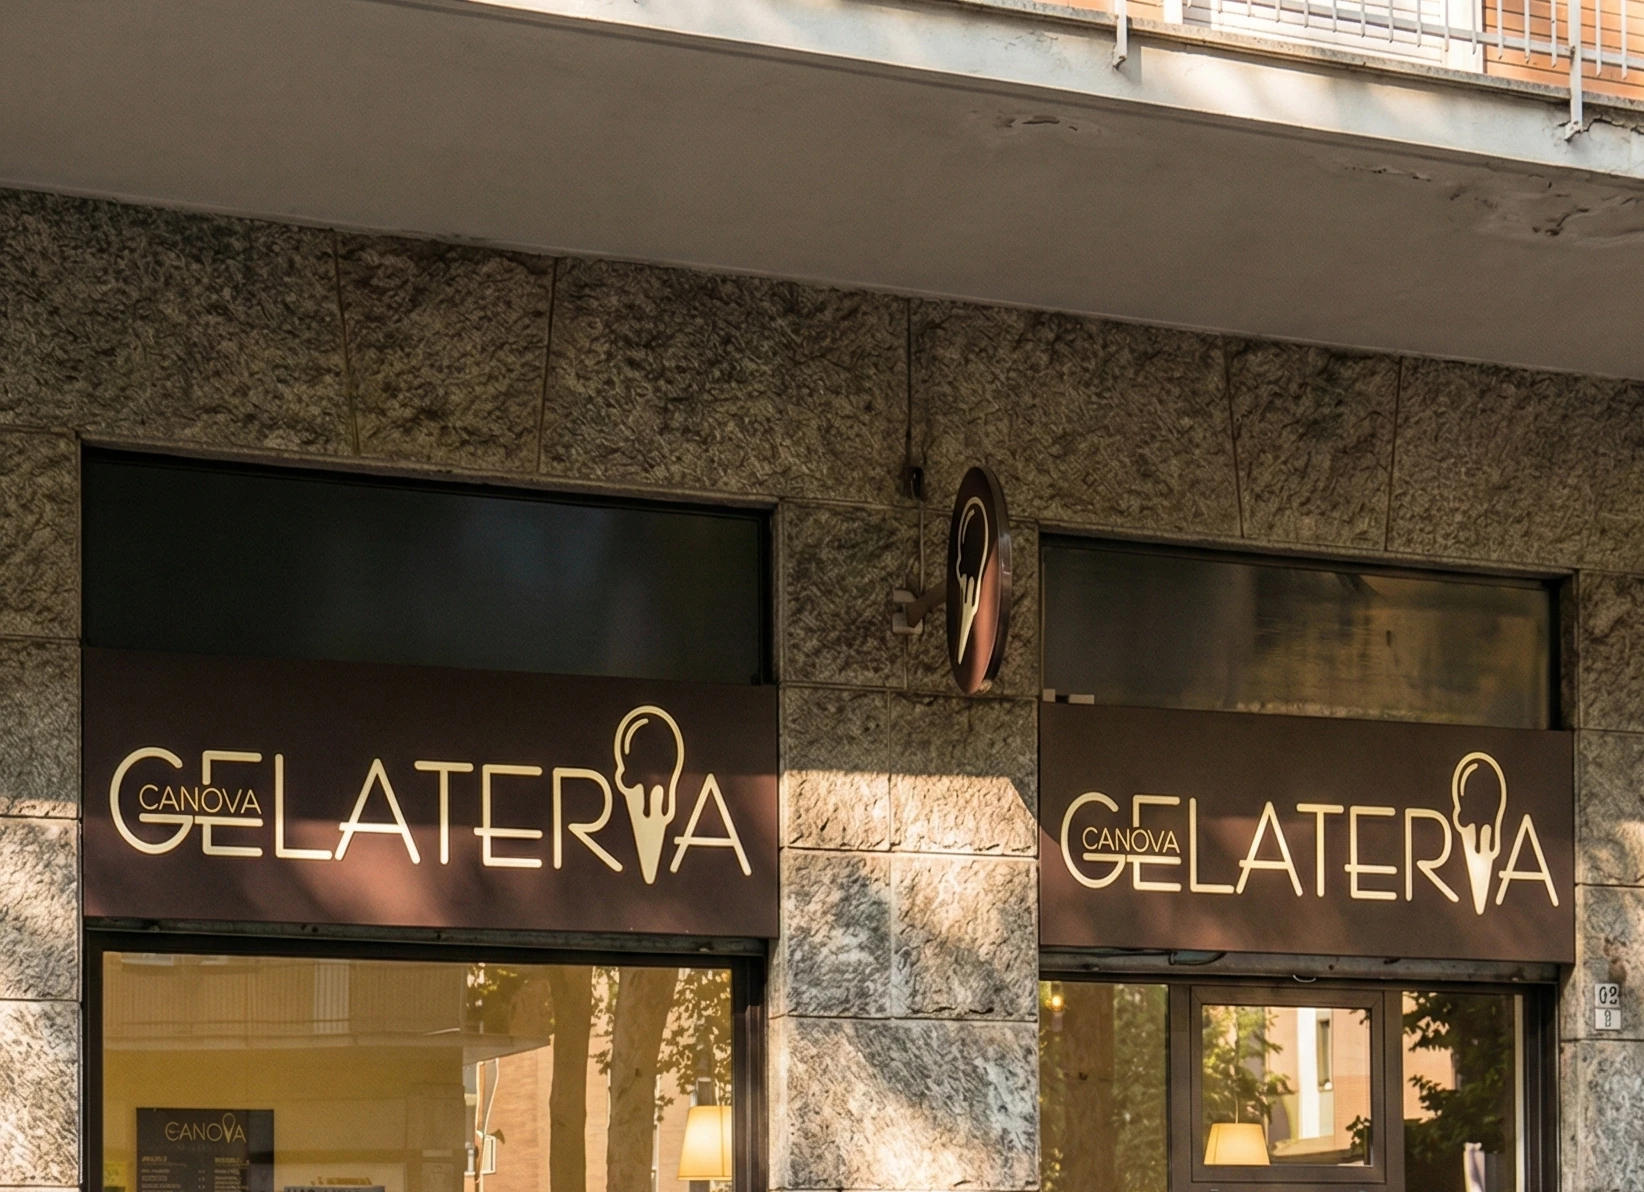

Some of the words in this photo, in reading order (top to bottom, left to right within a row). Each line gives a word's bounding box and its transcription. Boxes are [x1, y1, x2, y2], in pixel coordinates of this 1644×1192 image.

[109, 704, 752, 885] GELATERIA
[138, 783, 262, 814] CANOVA
[1060, 751, 1560, 916] GELATERIA
[1081, 826, 1181, 854] CANOVA
[164, 1112, 247, 1143] CANOVA
